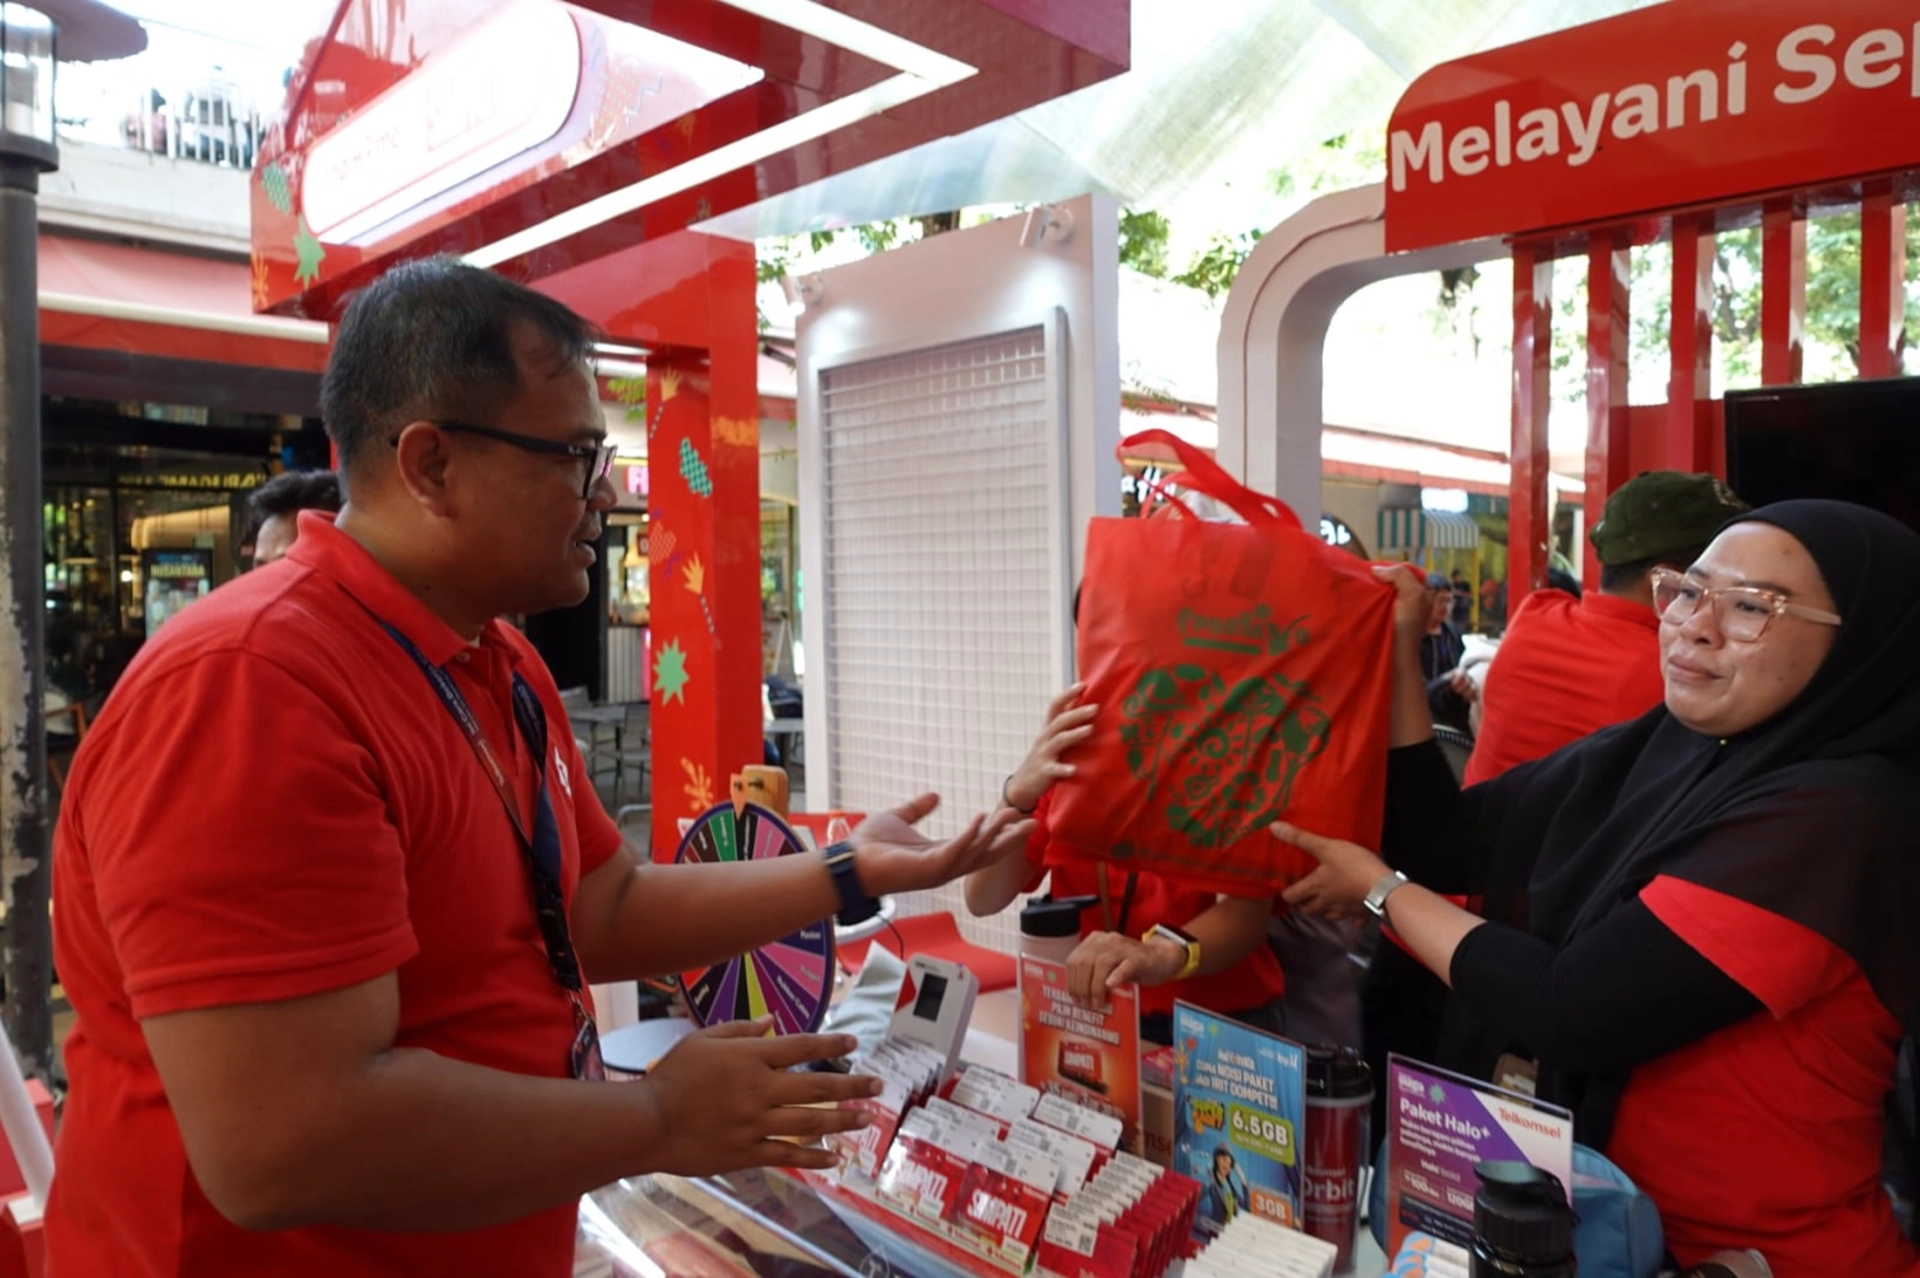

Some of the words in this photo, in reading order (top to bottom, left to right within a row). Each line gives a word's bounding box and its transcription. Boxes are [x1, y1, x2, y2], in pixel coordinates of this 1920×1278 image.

[1391, 40, 1747, 192] Melayani
[1242, 1070, 1275, 1094] PAKET
[1232, 1110, 1289, 1147] 6.5GB
[1400, 1098, 1443, 1126] Paket
[1444, 1114, 1491, 1141] Halo+
[1499, 1106, 1562, 1140] Telkomsel
[966, 1188, 1029, 1240] SIMPATI
[1255, 1193, 1287, 1221] 3GB
